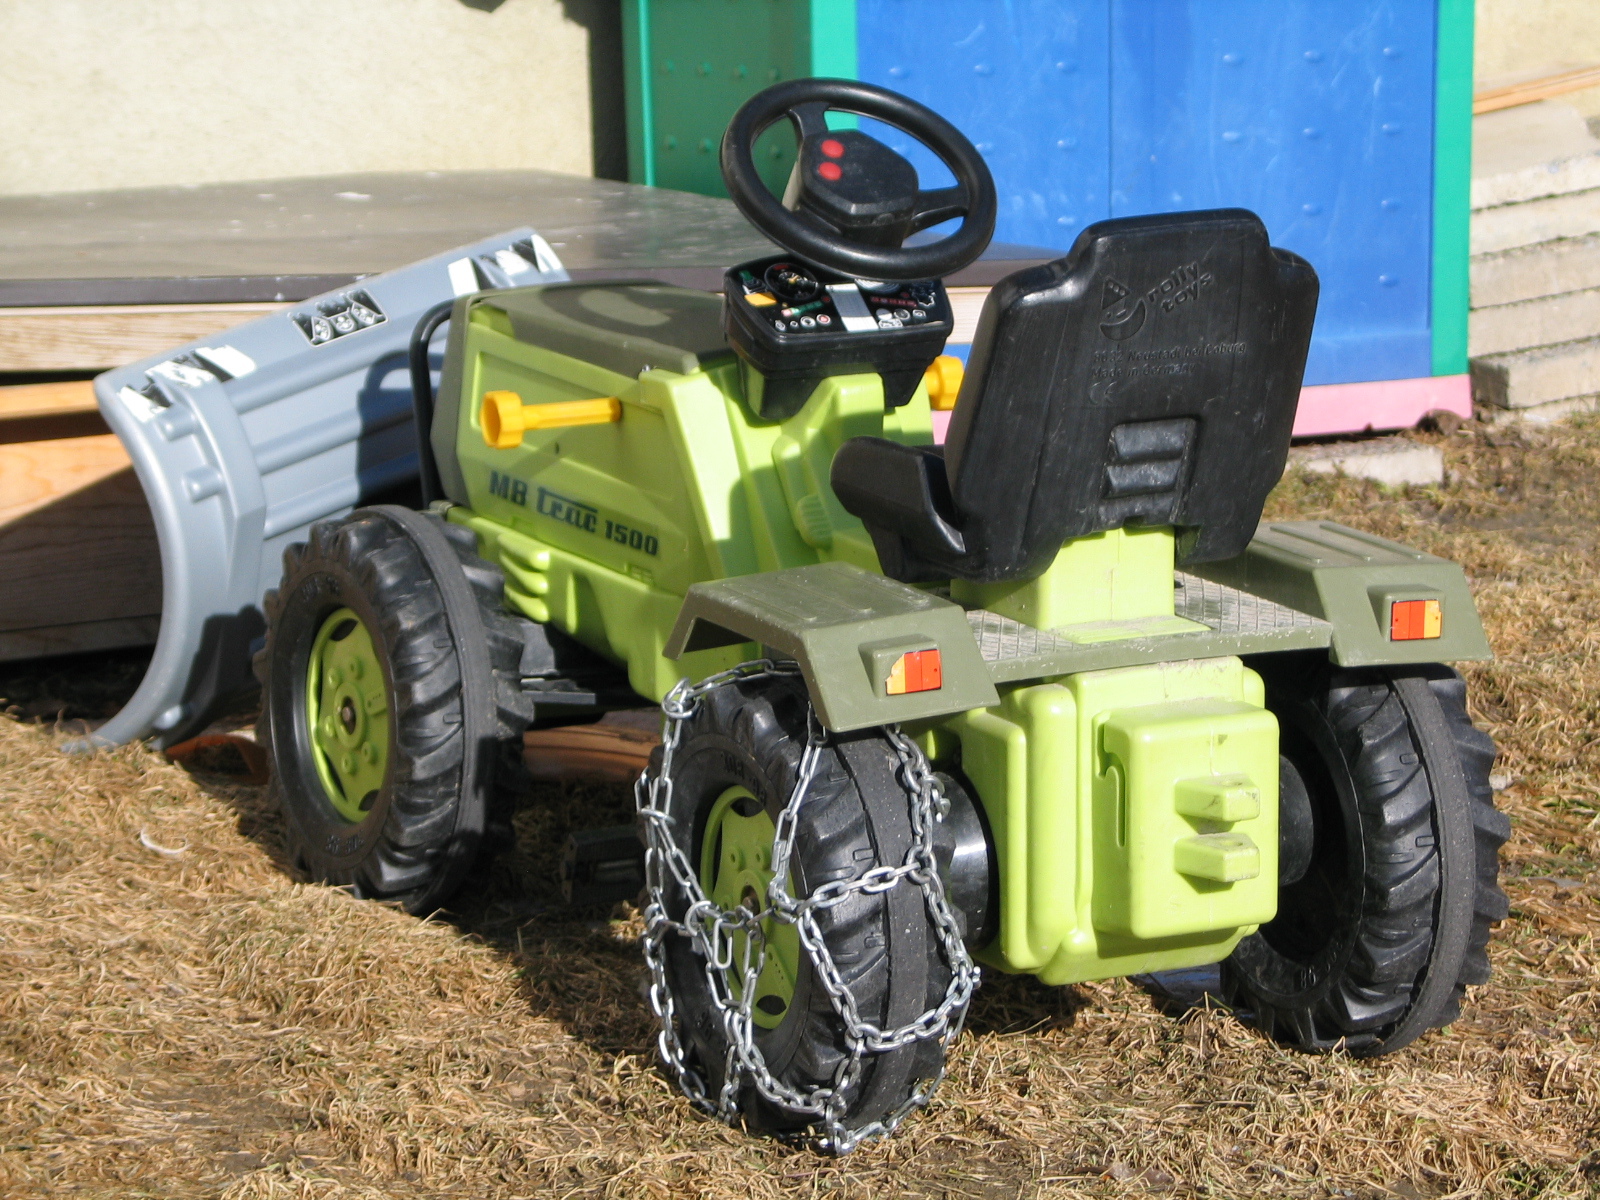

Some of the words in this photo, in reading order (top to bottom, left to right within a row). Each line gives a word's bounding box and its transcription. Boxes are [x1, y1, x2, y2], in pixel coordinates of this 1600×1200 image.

[1147, 261, 1200, 303] rolly
[1160, 272, 1213, 313] toys
[1091, 365, 1122, 379] Made
[1127, 365, 1139, 377] in
[1142, 363, 1196, 377] Germany
[1127, 345, 1181, 362] Neustadt
[488, 470, 528, 507] MB
[604, 519, 660, 557] 1500
